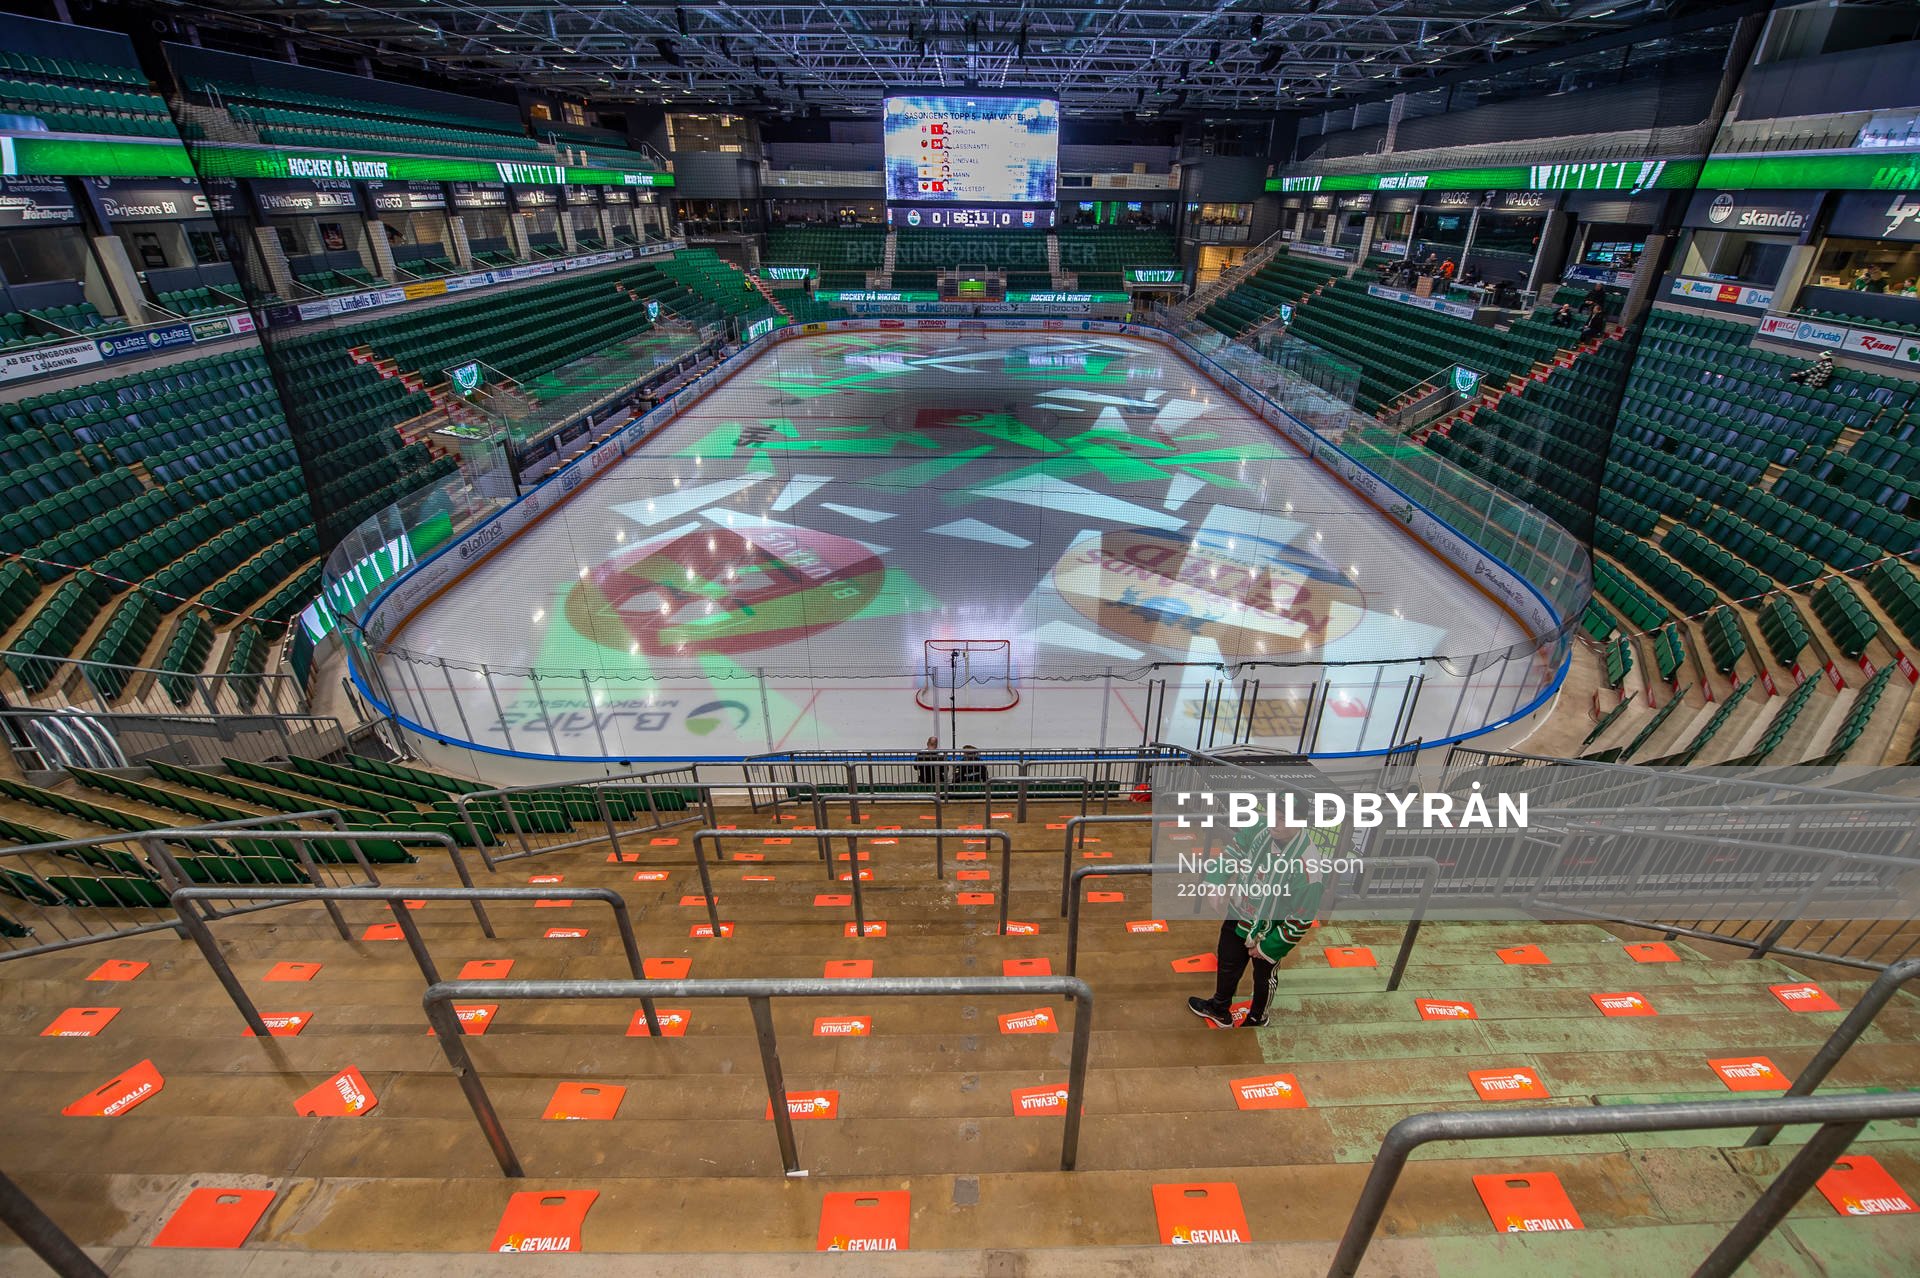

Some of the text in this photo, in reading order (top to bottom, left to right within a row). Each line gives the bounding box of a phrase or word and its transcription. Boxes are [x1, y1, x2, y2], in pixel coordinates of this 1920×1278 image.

[950, 112, 970, 120] TOPP
[288, 155, 388, 178] HOCKEY PÅ RIKTIGT
[1440, 192, 1470, 205] VIP-LOGE
[1505, 192, 1544, 206] VIP-LOGE
[162, 201, 177, 214] Bil
[953, 212, 990, 224] 56:11
[1739, 210, 1800, 228] skandia
[840, 291, 901, 301] HOCKEY PÅ RIKTIGT
[1030, 294, 1056, 302] HOCKEY
[1056, 292, 1066, 302] PÅ
[1761, 319, 1778, 333] LM
[161, 328, 191, 341] BJÄRE
[1811, 329, 1841, 343] Lindab
[115, 336, 147, 350] BJÄRE
[6, 358, 18, 367] AB
[1781, 989, 1812, 1001] GEVALIA
[1602, 997, 1634, 1009] GEVALIA
[1425, 1005, 1458, 1016] GEVALIA
[821, 1025, 852, 1034] GEVALIA
[1007, 1018, 1038, 1030] GEVALIA
[1723, 1065, 1762, 1080] GEVALIA
[336, 1075, 356, 1104] GEVALIA
[1482, 1077, 1519, 1091] GEVALIA
[103, 1082, 153, 1116] GEVALIA
[1241, 1086, 1280, 1100] GEVALIA
[1021, 1095, 1059, 1108] GEVALIA
[1864, 1197, 1909, 1214] GEVALIA
[1523, 1217, 1575, 1231] GEVALIA
[1190, 1229, 1241, 1244] GEVALIA
[520, 1236, 571, 1252] GEVALIA
[847, 1238, 898, 1252] GEVALIA
